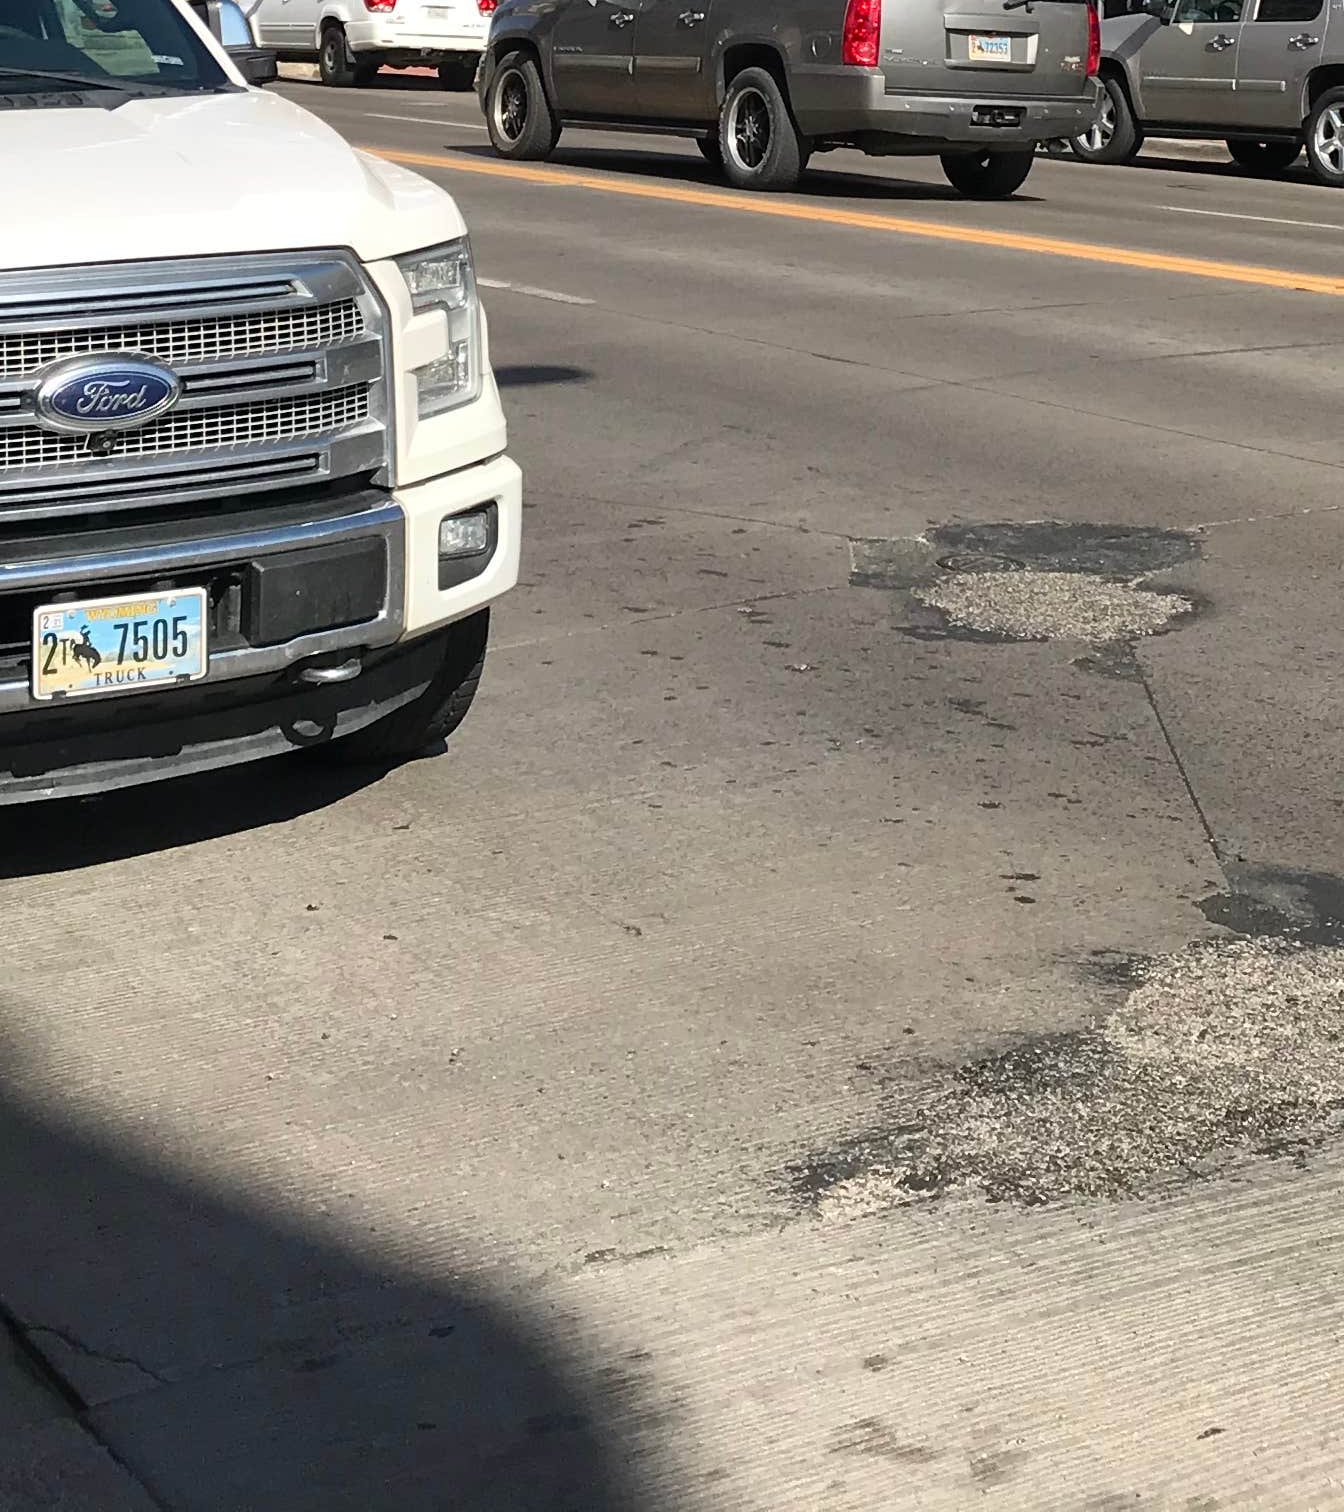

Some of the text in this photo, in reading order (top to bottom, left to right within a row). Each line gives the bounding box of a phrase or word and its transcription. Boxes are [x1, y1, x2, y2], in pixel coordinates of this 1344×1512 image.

[76, 379, 147, 414] Ford
[113, 615, 188, 666] 7505
[94, 668, 147, 687] TRUCK
